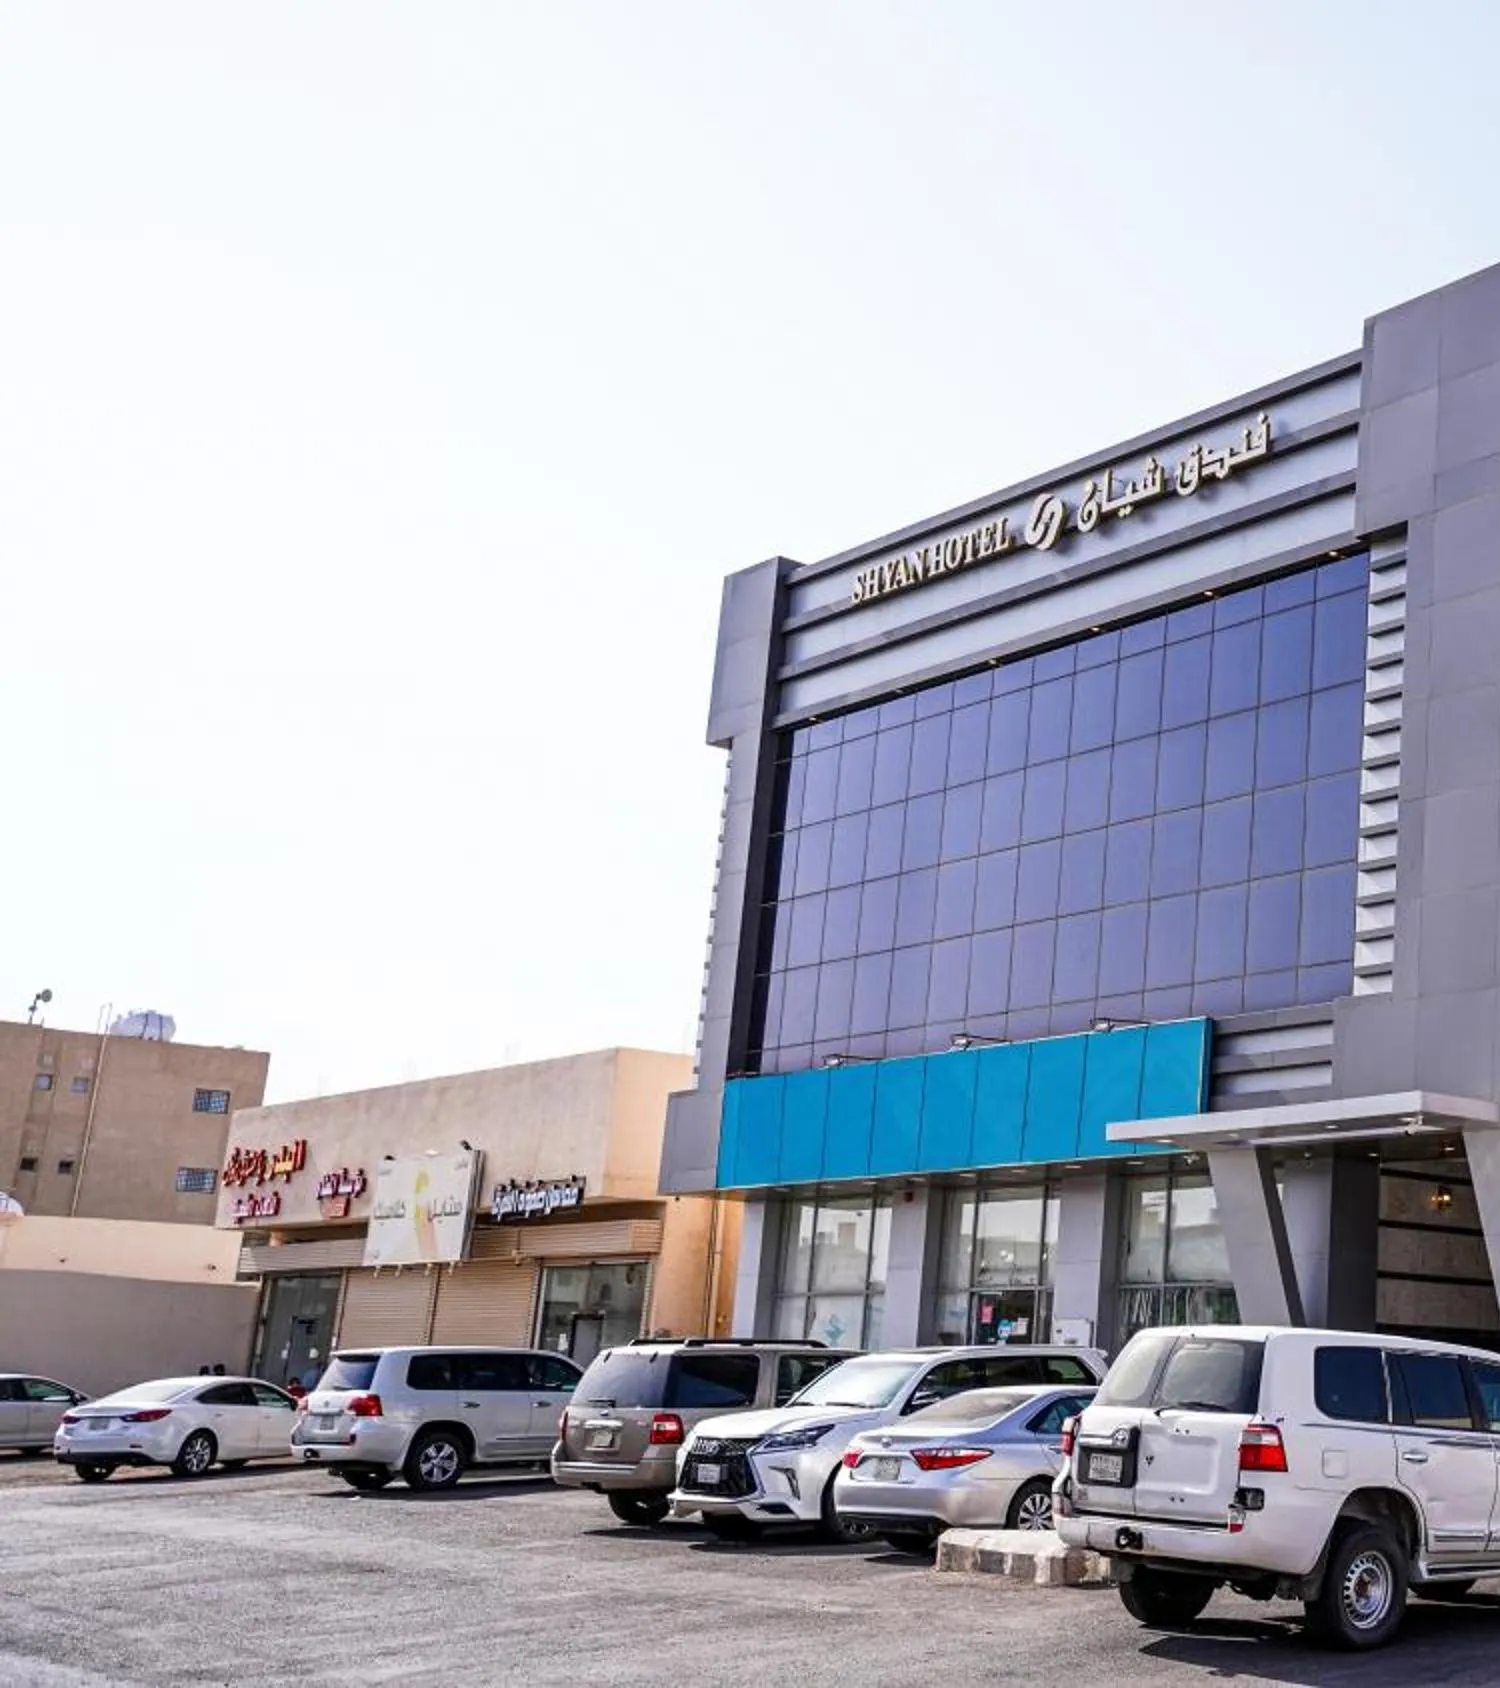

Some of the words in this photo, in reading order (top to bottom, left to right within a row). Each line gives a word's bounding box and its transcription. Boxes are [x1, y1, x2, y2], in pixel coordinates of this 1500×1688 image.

[1077, 456, 1165, 532] شيان
[1176, 412, 1272, 496] فندق
[851, 548, 929, 603] SHYAN
[928, 517, 1011, 577] HOTEL
